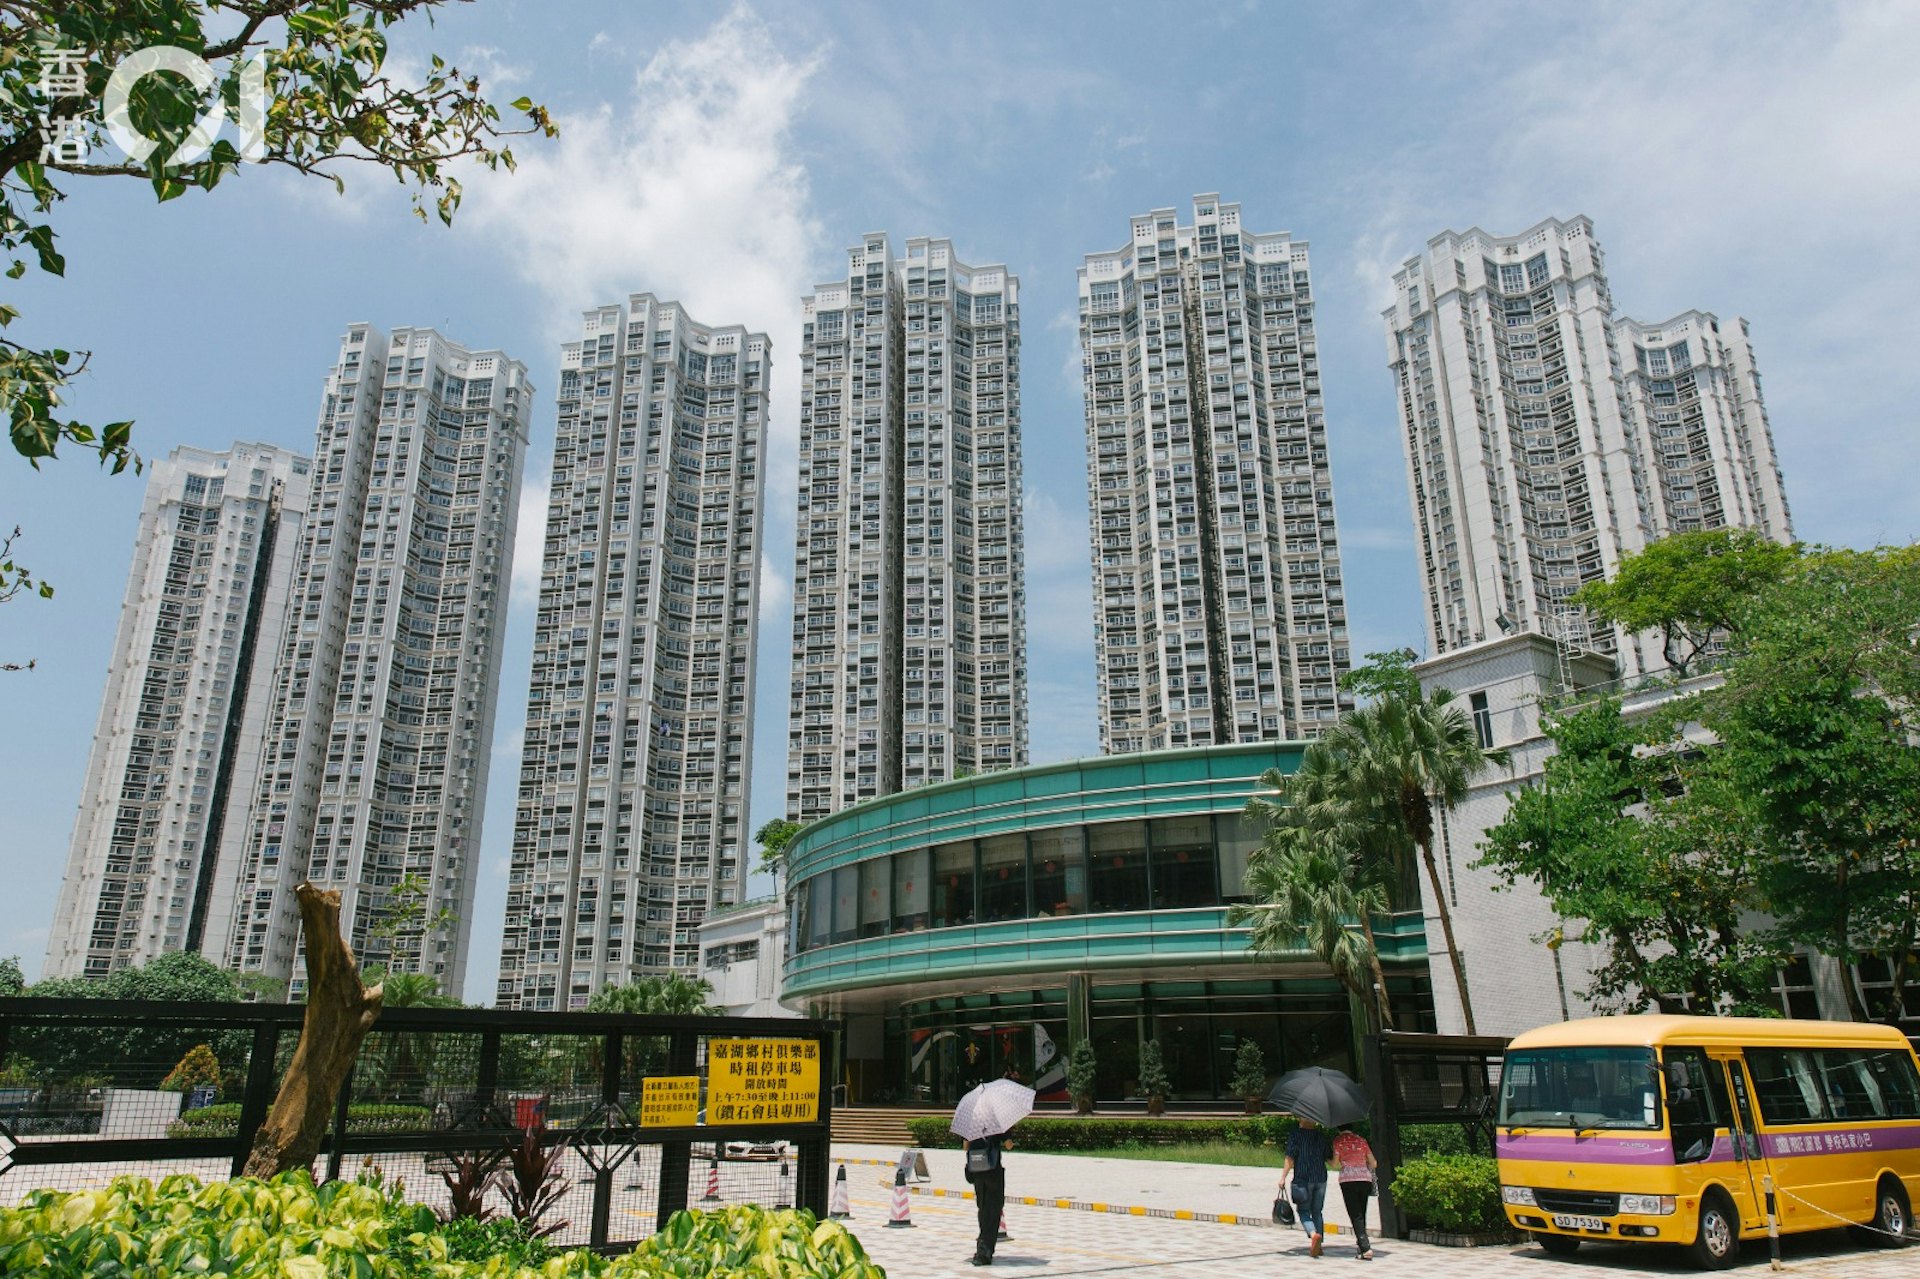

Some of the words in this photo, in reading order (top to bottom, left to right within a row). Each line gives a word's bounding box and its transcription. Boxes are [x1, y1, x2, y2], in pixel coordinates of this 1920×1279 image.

[715, 1043, 816, 1059] 嘉湖鄉村俱樂部
[730, 1061, 802, 1076] 時租停車場
[744, 1078, 787, 1090] 開放時間
